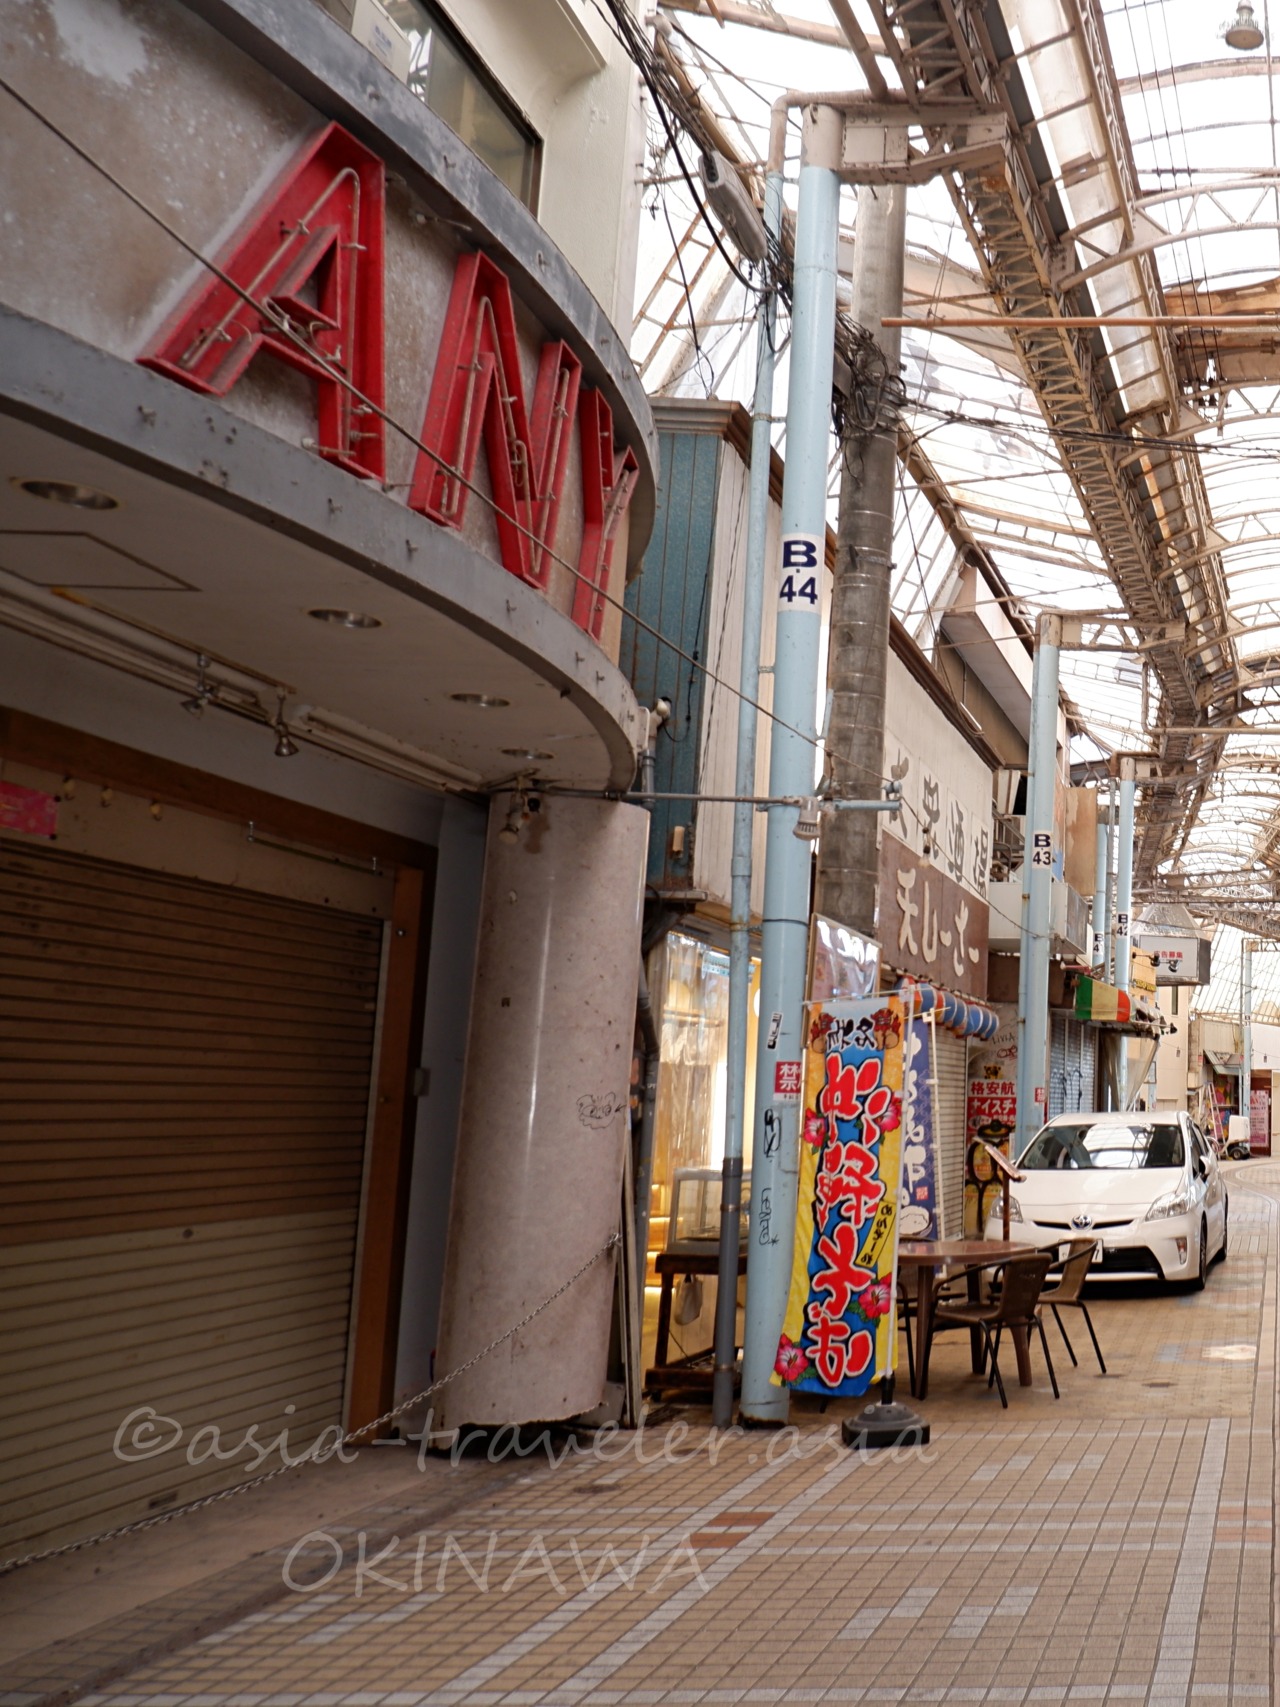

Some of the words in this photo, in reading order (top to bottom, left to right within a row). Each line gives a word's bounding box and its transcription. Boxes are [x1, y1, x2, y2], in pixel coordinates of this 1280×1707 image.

[782, 539, 818, 568] B
[779, 575, 818, 605] 44
[1033, 833, 1050, 848] B
[1032, 850, 1052, 866] 43
